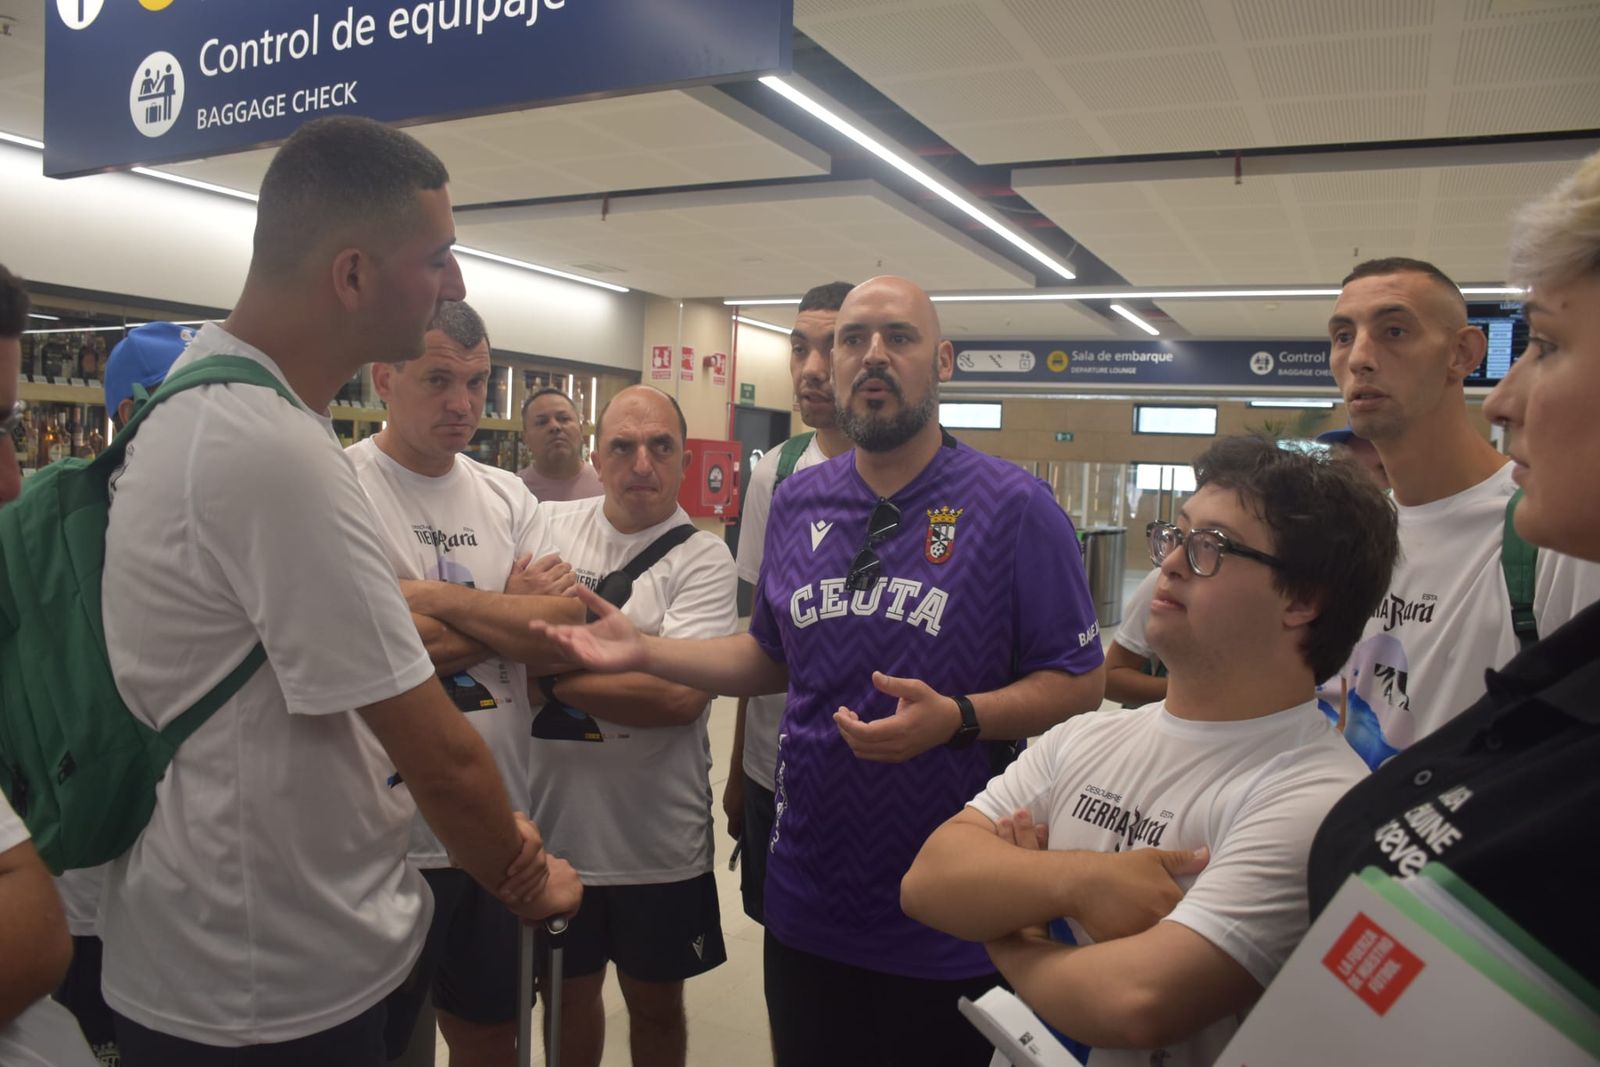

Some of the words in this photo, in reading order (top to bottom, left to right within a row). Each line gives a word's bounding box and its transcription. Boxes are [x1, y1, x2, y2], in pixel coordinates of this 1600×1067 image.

[199, 14, 319, 77] Control
[331, 6, 376, 52] de
[388, 0, 565, 44] equipaje
[196, 94, 287, 131] BAGGAGE
[291, 81, 359, 114] CHECK
[1071, 350, 1095, 362] Sala
[1097, 350, 1112, 362] de
[1114, 350, 1174, 364] embarque
[1071, 366, 1108, 374] DEPARTURE
[1109, 367, 1137, 375] LOUNGE
[1278, 351, 1326, 363] Control
[1278, 368, 1313, 376] BAGGAGE
[789, 577, 950, 637] CEUTA
[1383, 592, 1436, 632] Rara
[1084, 784, 1123, 803] DESCUBRE
[1071, 793, 1131, 837] TIERRA
